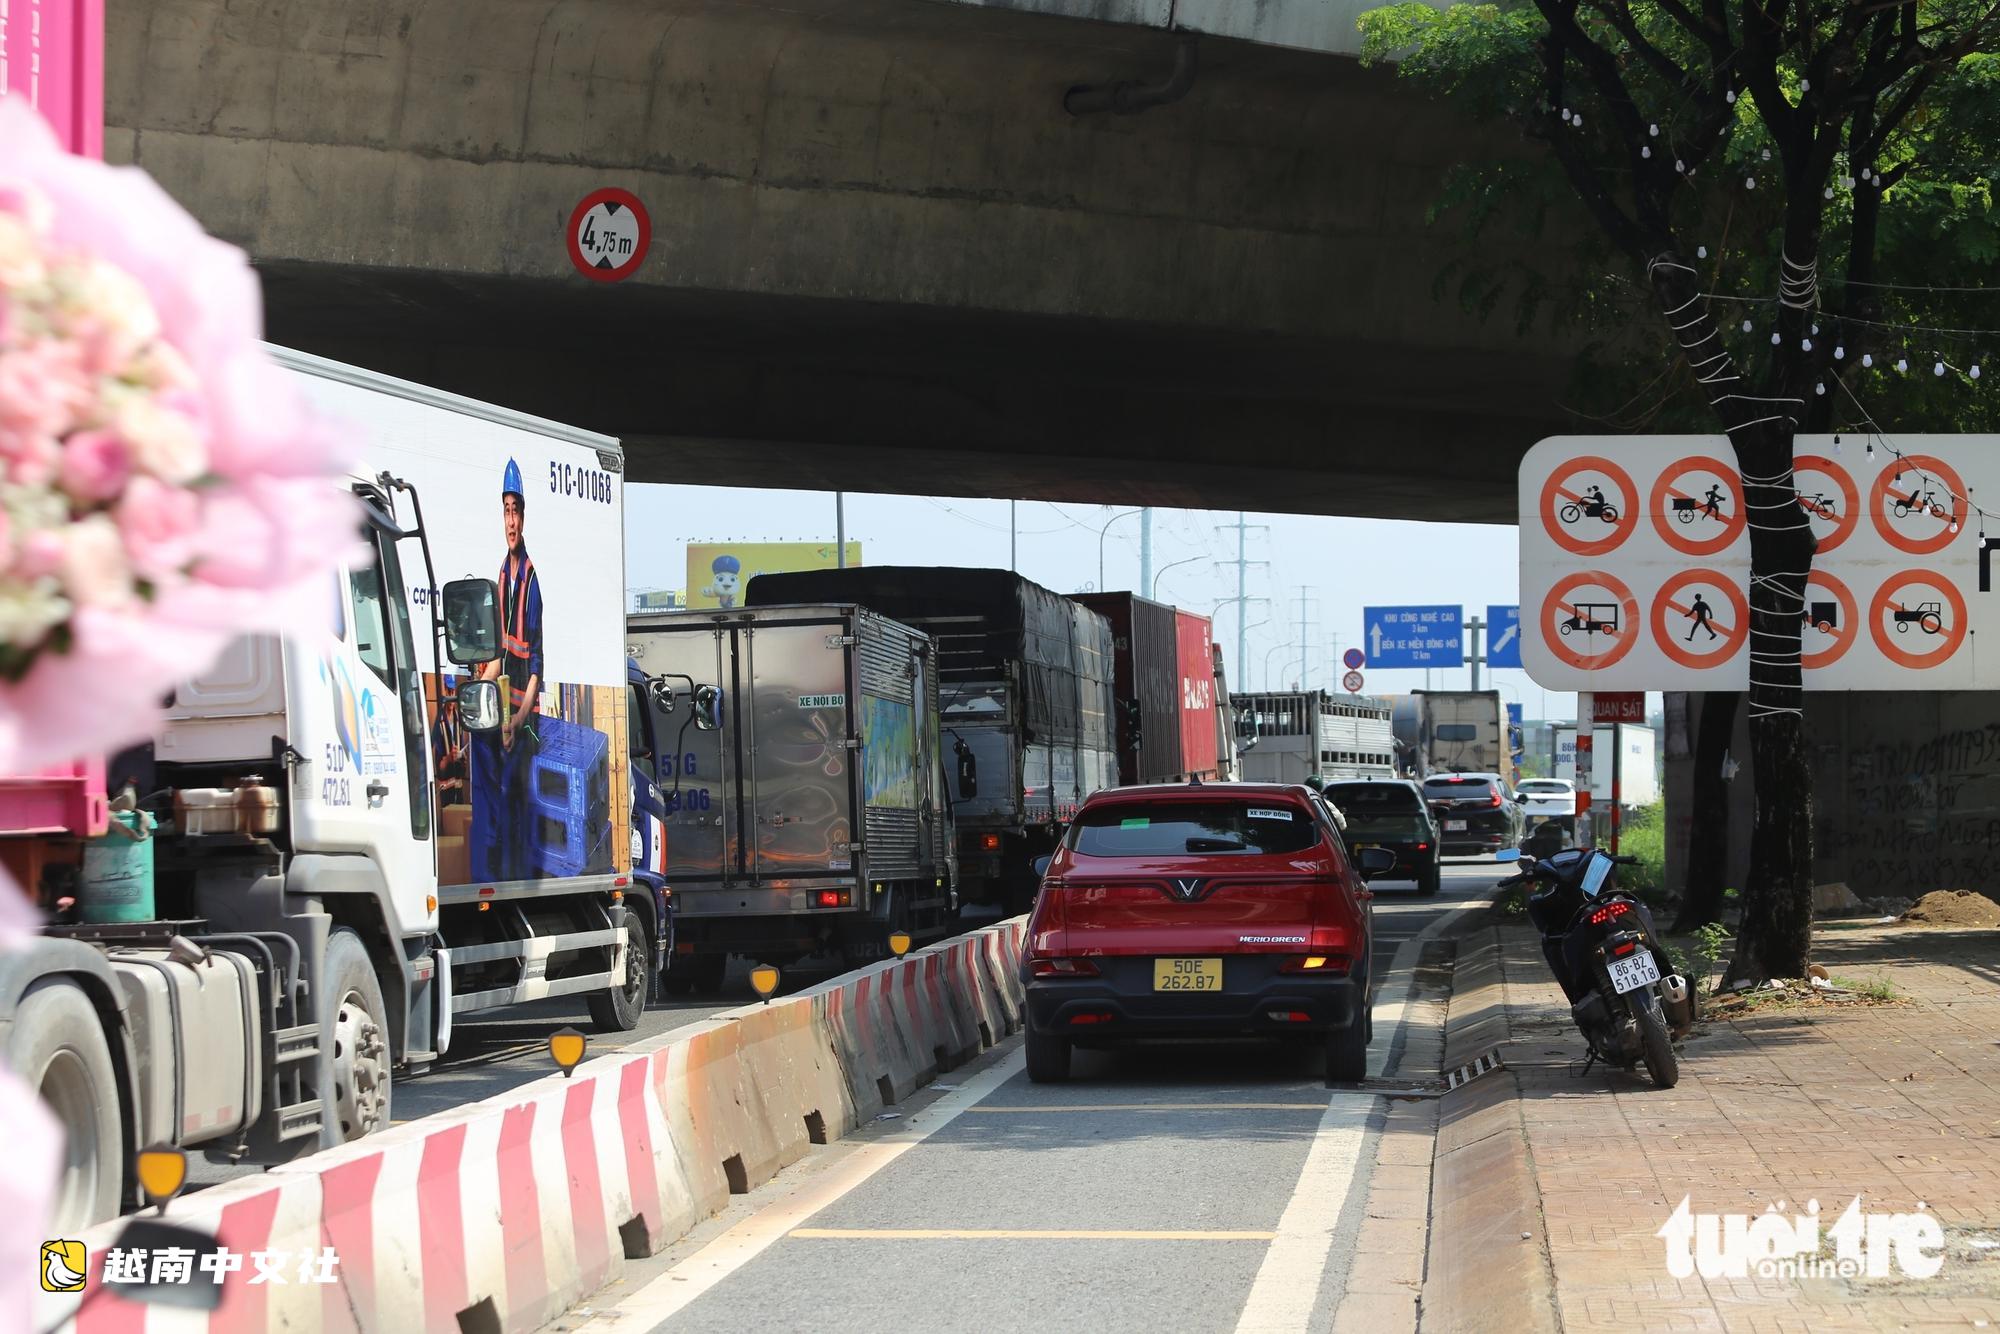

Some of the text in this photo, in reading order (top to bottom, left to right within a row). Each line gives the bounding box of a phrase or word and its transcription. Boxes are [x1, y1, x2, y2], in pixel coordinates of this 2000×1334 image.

[581, 215, 632, 254] 4,75 m
[550, 461, 612, 504] 51C-01068
[800, 697, 811, 707] XE
[1622, 699, 1642, 717] SÁT
[325, 743, 345, 773] 51D
[323, 777, 352, 806] 472.81
[1174, 960, 1203, 974] 50E
[1614, 956, 1648, 977] 86-B2
[1161, 975, 1215, 990] 262.87
[1615, 967, 1656, 991] 518.18
